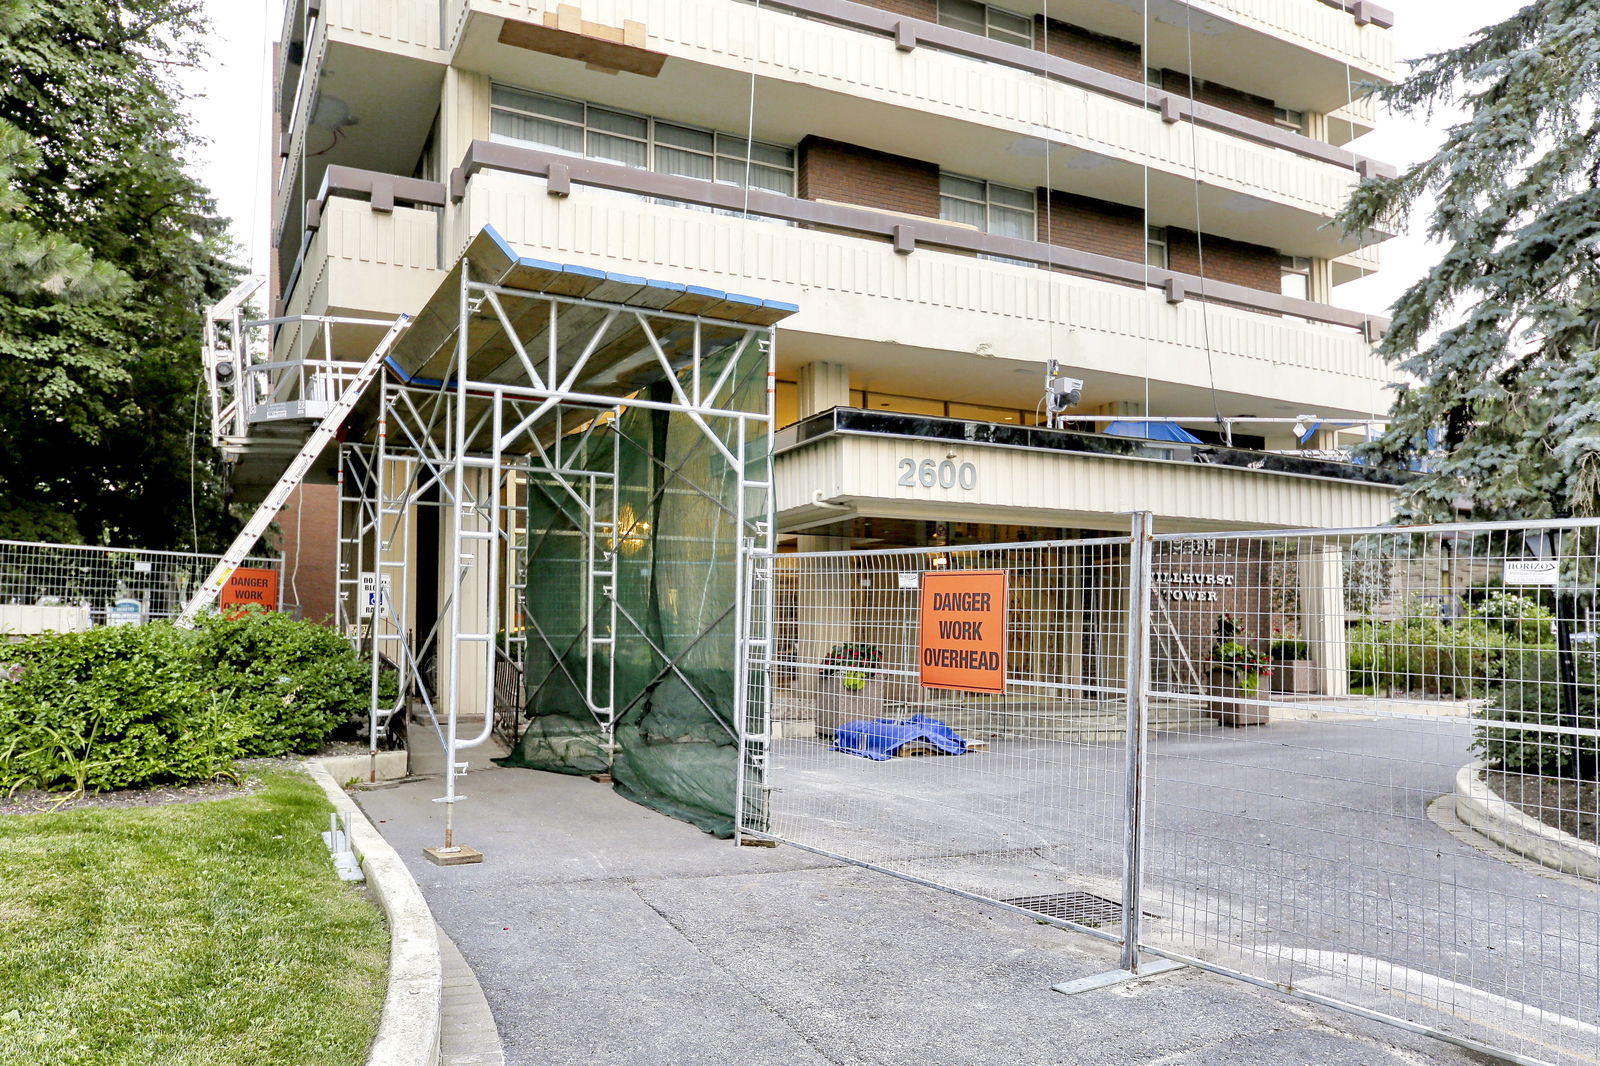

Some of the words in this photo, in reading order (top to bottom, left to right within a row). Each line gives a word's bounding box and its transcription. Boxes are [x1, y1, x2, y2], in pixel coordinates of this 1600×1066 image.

[898, 457, 977, 490] 2600
[231, 576, 268, 588] DANGER
[235, 589, 263, 600] WORK
[933, 592, 991, 612] DANGER
[1163, 589, 1218, 601] TOWER
[939, 620, 983, 641] WORK
[924, 647, 1000, 671] OVERHEAD
